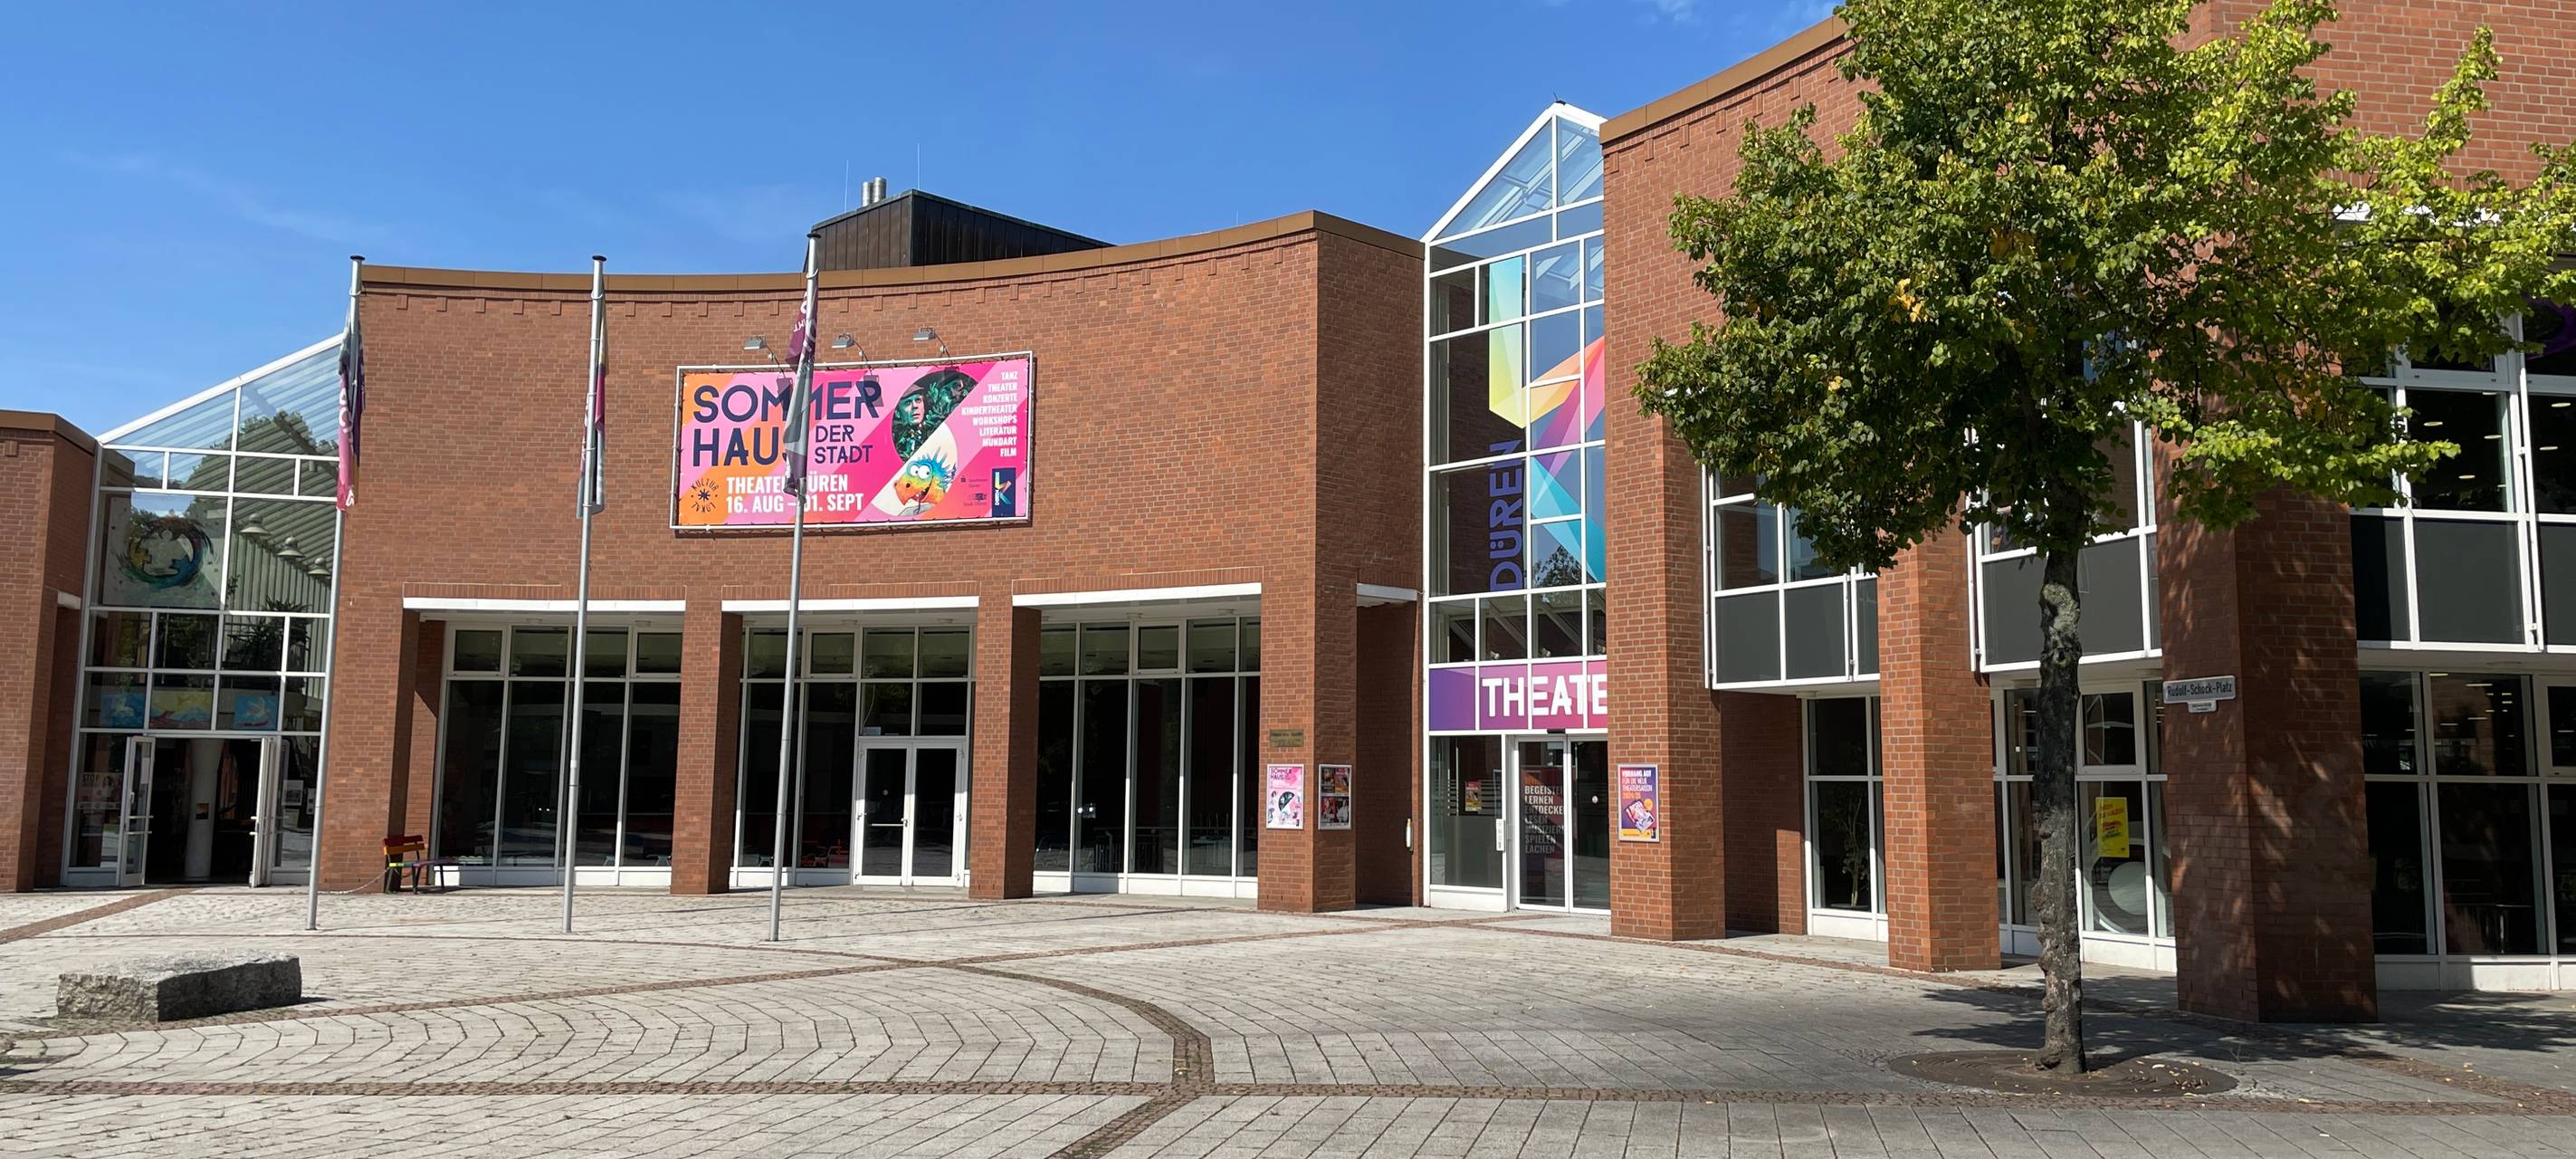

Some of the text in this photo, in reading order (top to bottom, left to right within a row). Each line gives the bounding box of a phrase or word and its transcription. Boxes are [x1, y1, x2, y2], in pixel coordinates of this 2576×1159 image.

[1000, 370, 1018, 380] TANZ
[987, 382, 1018, 392] THEATER
[983, 393, 1017, 404] KONZERTE
[961, 404, 1017, 416] KINDERTHEATER
[972, 415, 1017, 426] WORKSHOPS
[816, 425, 854, 443] DER
[978, 426, 1017, 436] LITERATUR
[693, 426, 787, 467] HAU
[982, 436, 1017, 446] MUNDART
[815, 445, 873, 464] STADT
[999, 447, 1017, 457] FILM
[807, 471, 848, 493] ÜREN
[726, 495, 748, 513] 16.
[752, 494, 784, 512] AUG
[827, 493, 864, 512] SEPT
[1490, 439, 1522, 592] DÜREN
[2166, 680, 2233, 697] Rudolf-Schock-Platz
[1482, 674, 1608, 717] THEATE
[1524, 795, 1554, 805] LERNEN
[1524, 805, 1564, 815] ENTDECKE
